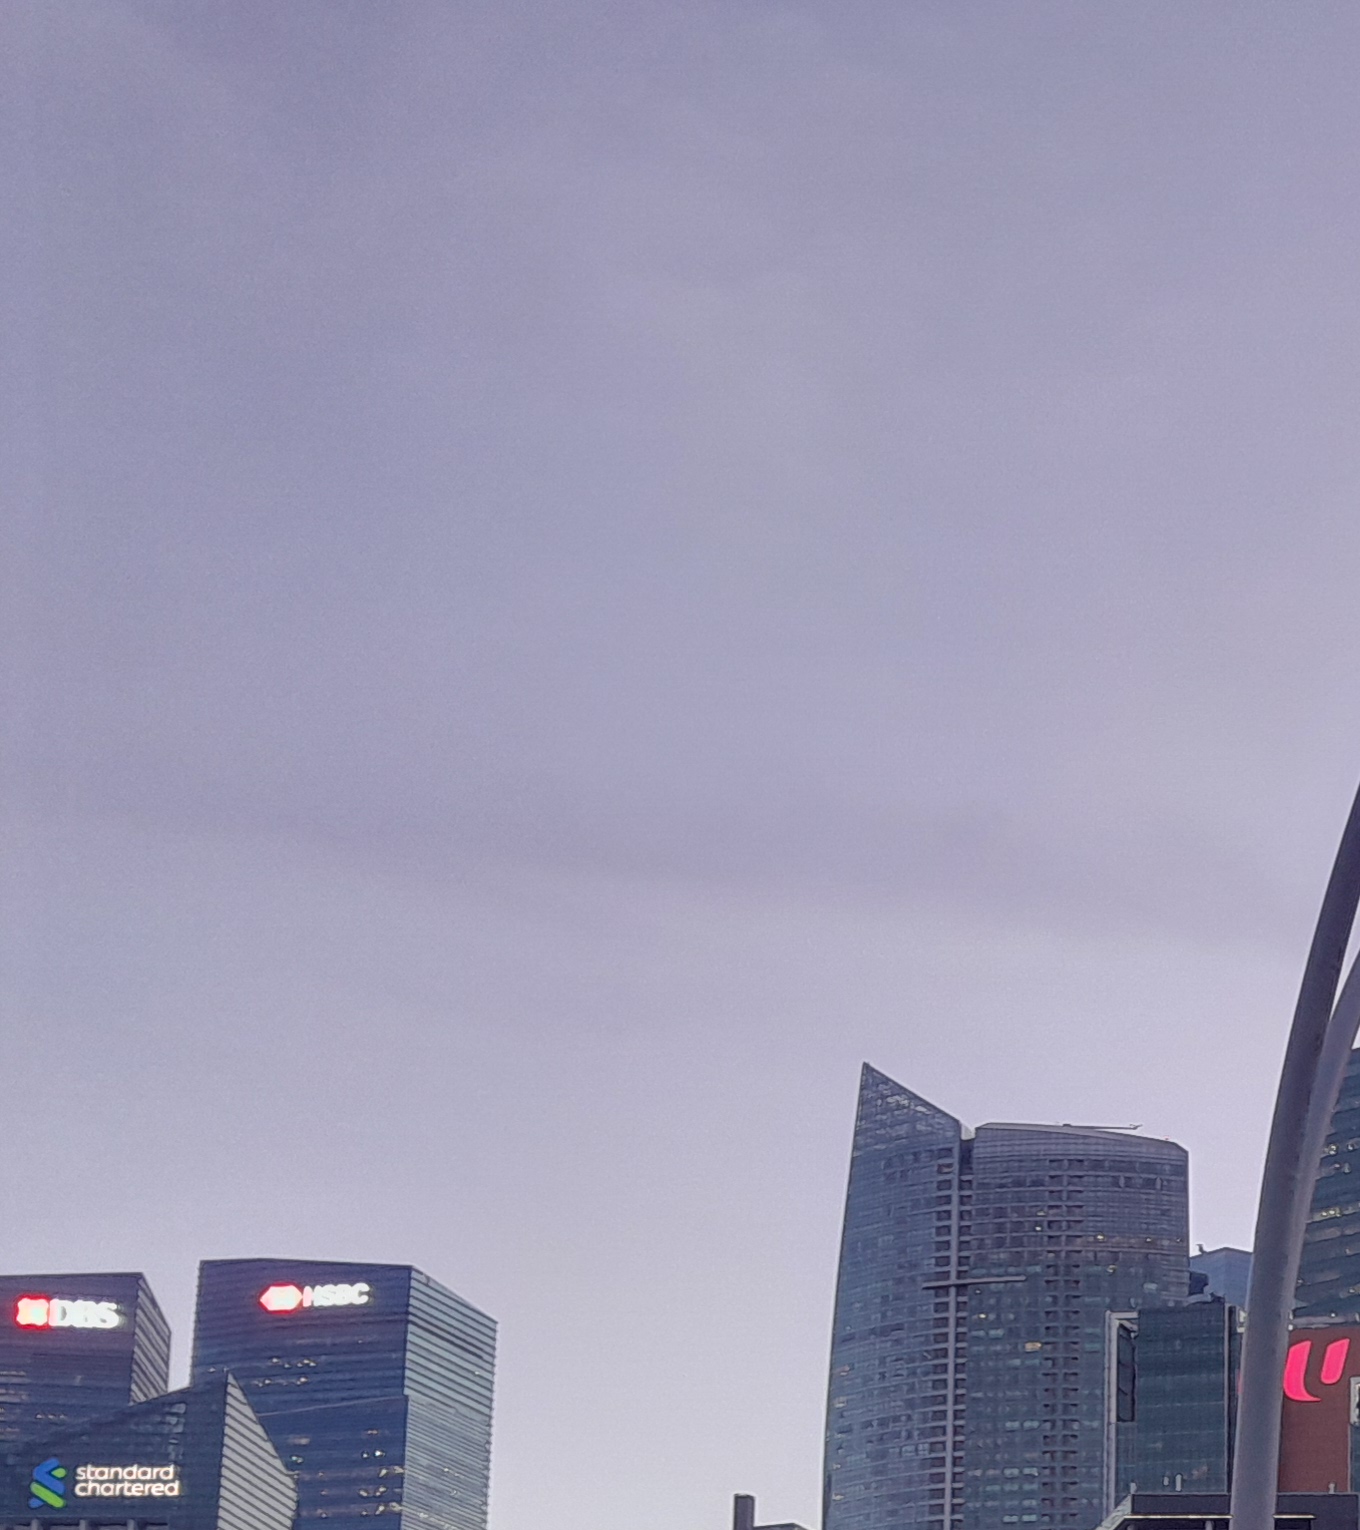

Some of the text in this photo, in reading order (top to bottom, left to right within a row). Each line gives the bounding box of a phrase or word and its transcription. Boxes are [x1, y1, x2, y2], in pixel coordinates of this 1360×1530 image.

[302, 1282, 370, 1308] HSBC
[48, 1299, 121, 1329] DBS
[75, 1463, 175, 1481] standard
[74, 1479, 181, 1497] chartered
